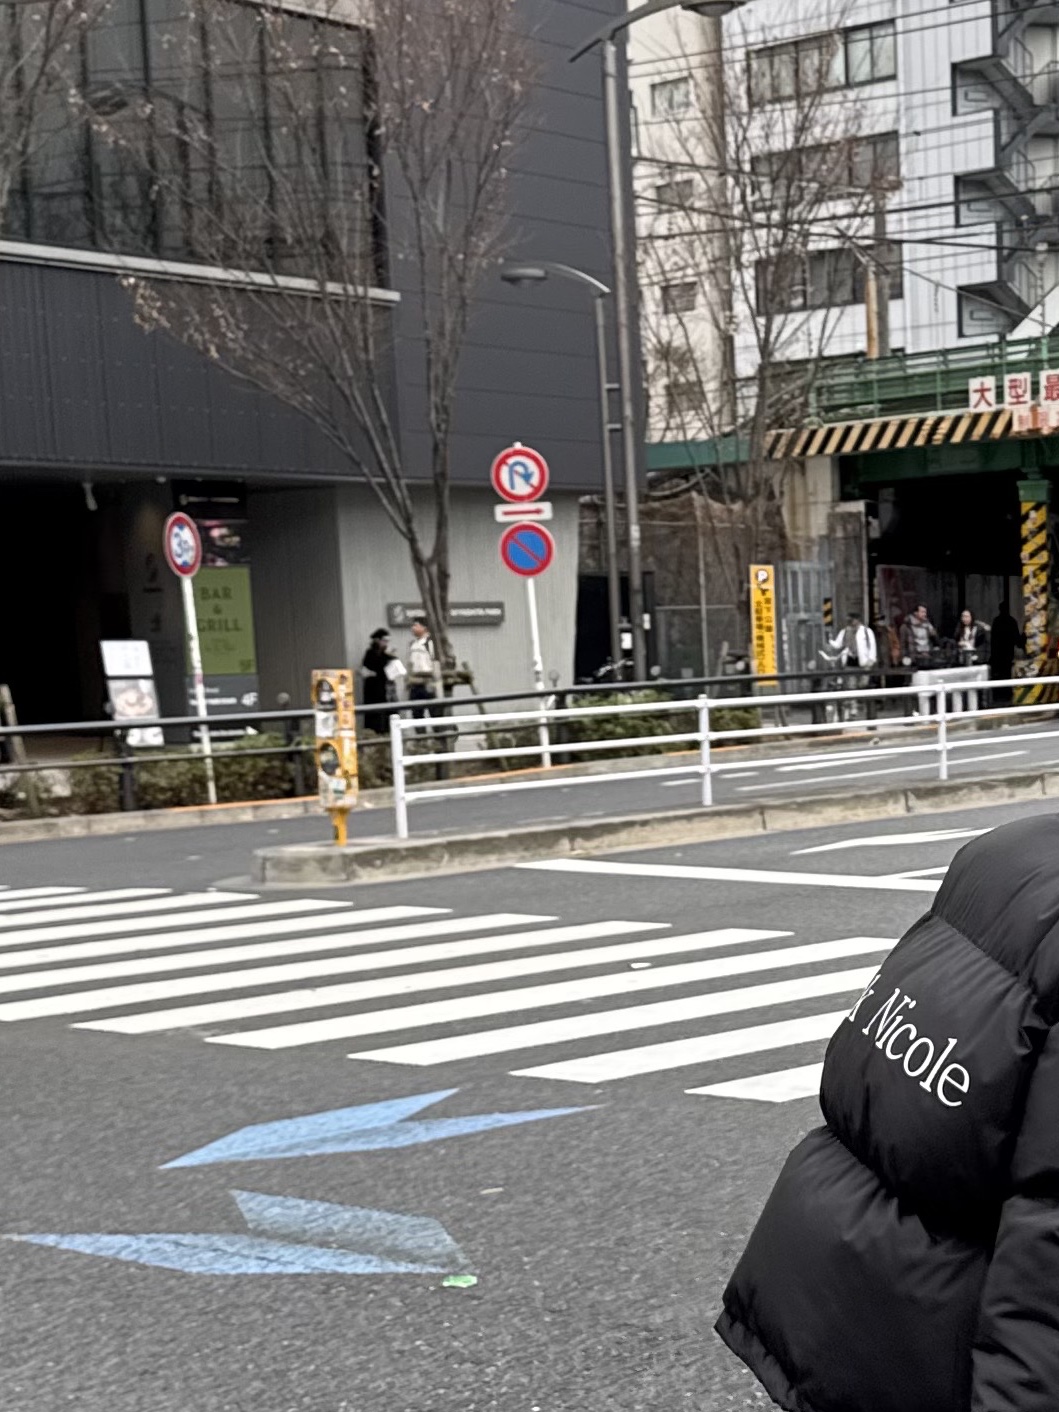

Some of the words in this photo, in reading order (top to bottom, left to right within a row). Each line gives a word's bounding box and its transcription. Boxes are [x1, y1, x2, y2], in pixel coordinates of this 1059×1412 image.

[201, 586, 232, 600] BAR
[197, 618, 242, 633] GRILL
[862, 988, 970, 1107] Nicole
